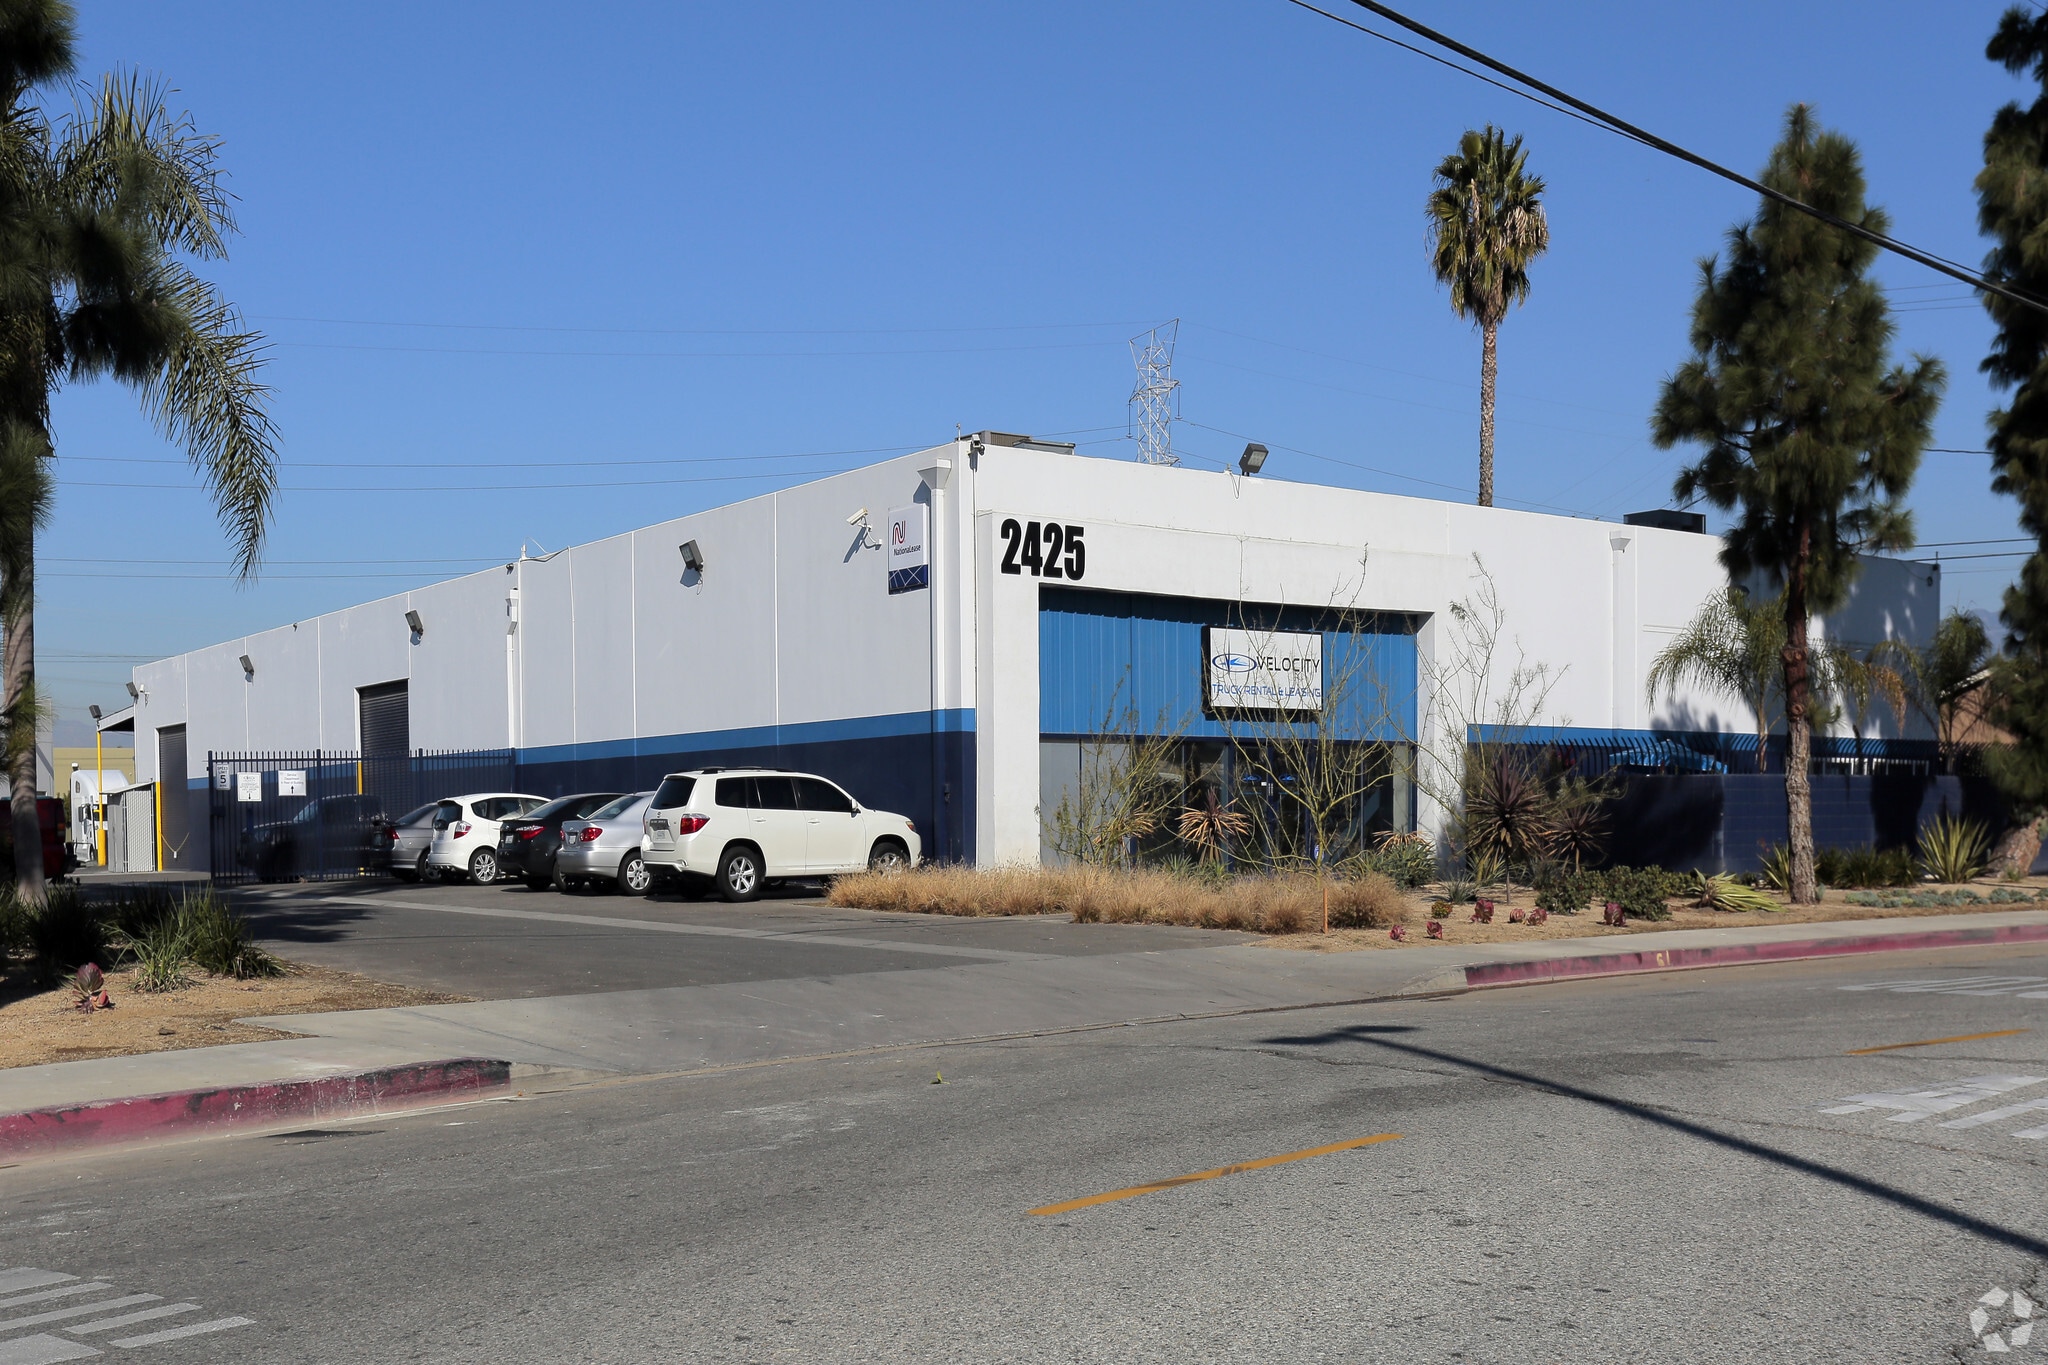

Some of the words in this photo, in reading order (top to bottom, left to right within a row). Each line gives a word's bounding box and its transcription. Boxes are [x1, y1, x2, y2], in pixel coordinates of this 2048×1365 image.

[1001, 518, 1086, 580] 2425
[1256, 656, 1320, 672] VELOCITY
[1212, 684, 1242, 695] TRUCK
[1244, 685, 1277, 696] RENTAL
[1278, 687, 1284, 696] &
[1285, 687, 1321, 698] LEASING
[220, 774, 227, 784] 5
